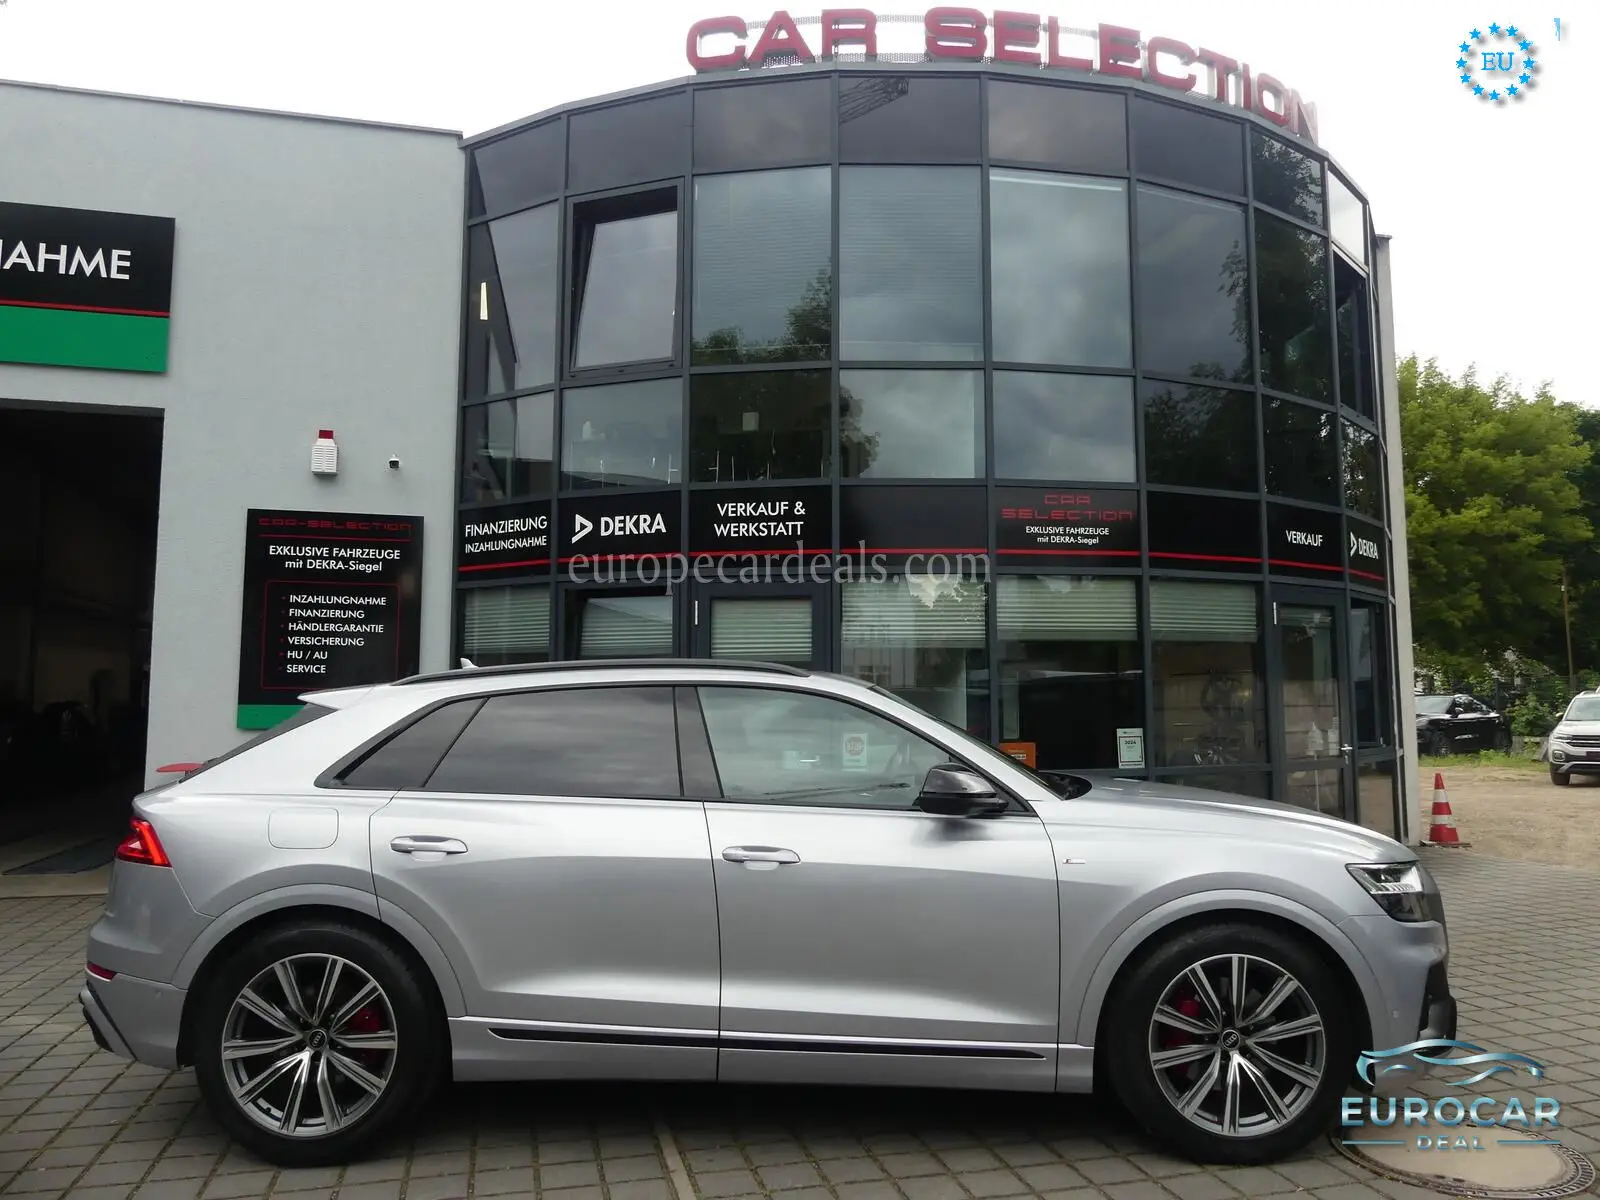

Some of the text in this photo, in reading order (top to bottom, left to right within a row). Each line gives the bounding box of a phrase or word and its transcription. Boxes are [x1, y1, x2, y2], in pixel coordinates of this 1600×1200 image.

[686, 6, 1319, 146] CAR SELECTION
[0, 238, 132, 280] AHME
[1044, 494, 1091, 505] CAR
[717, 501, 806, 517] VERKAUF &
[1002, 508, 1134, 521] SELECTION
[465, 515, 548, 538] FINANZIERUNG
[600, 513, 667, 537] DEKRA
[714, 521, 804, 538] WERKSTATT
[1026, 525, 1110, 536] EXKLUSIVE FAHRZEUGE
[465, 535, 548, 554] INZAHLUNGNAHME
[1037, 535, 1099, 546] mit DEKRA-Siegel
[1285, 529, 1323, 547] VERKAUF
[269, 545, 401, 560] EXKLUSIVE FAHRZEUGE
[1358, 538, 1379, 559] DEKRA
[285, 559, 383, 573] mit DEKRA-Siegel
[289, 594, 387, 605] INZAHLUNGNAHME
[289, 608, 365, 618] FINANZIERUNG
[288, 621, 384, 633] HÄNDLERGARANTIE
[287, 636, 365, 646] VERSICHERUNG
[287, 650, 303, 660] HU
[312, 651, 328, 660] AU
[286, 664, 326, 673] SERVICE
